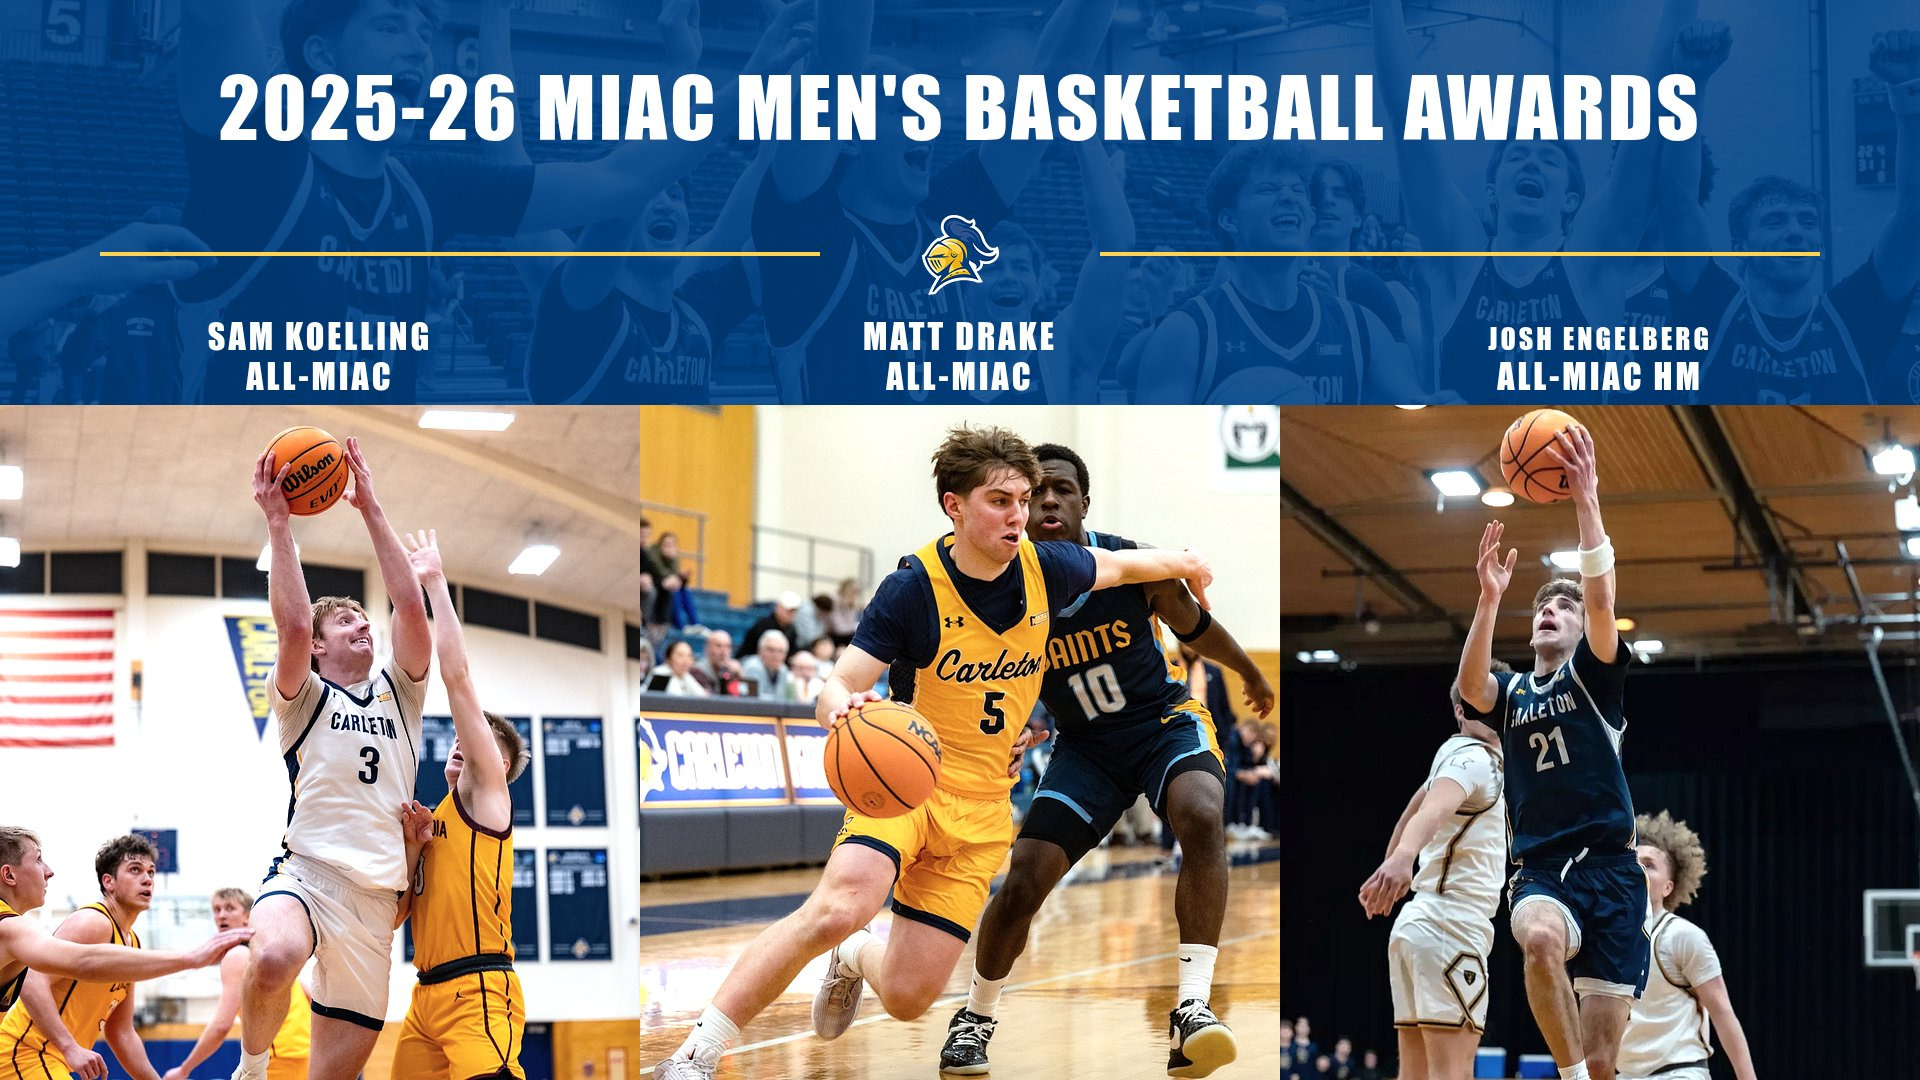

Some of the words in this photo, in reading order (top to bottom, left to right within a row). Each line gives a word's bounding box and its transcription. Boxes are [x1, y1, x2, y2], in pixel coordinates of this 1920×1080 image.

[45, 0, 81, 45] 5
[281, 453, 335, 492] Wilson
[936, 649, 1042, 683] Carleton
[1044, 619, 1131, 672] AINTS
[979, 691, 1006, 735] 5
[1067, 663, 1126, 721] 10
[358, 746, 380, 785] 3
[1528, 725, 1570, 772] 21
